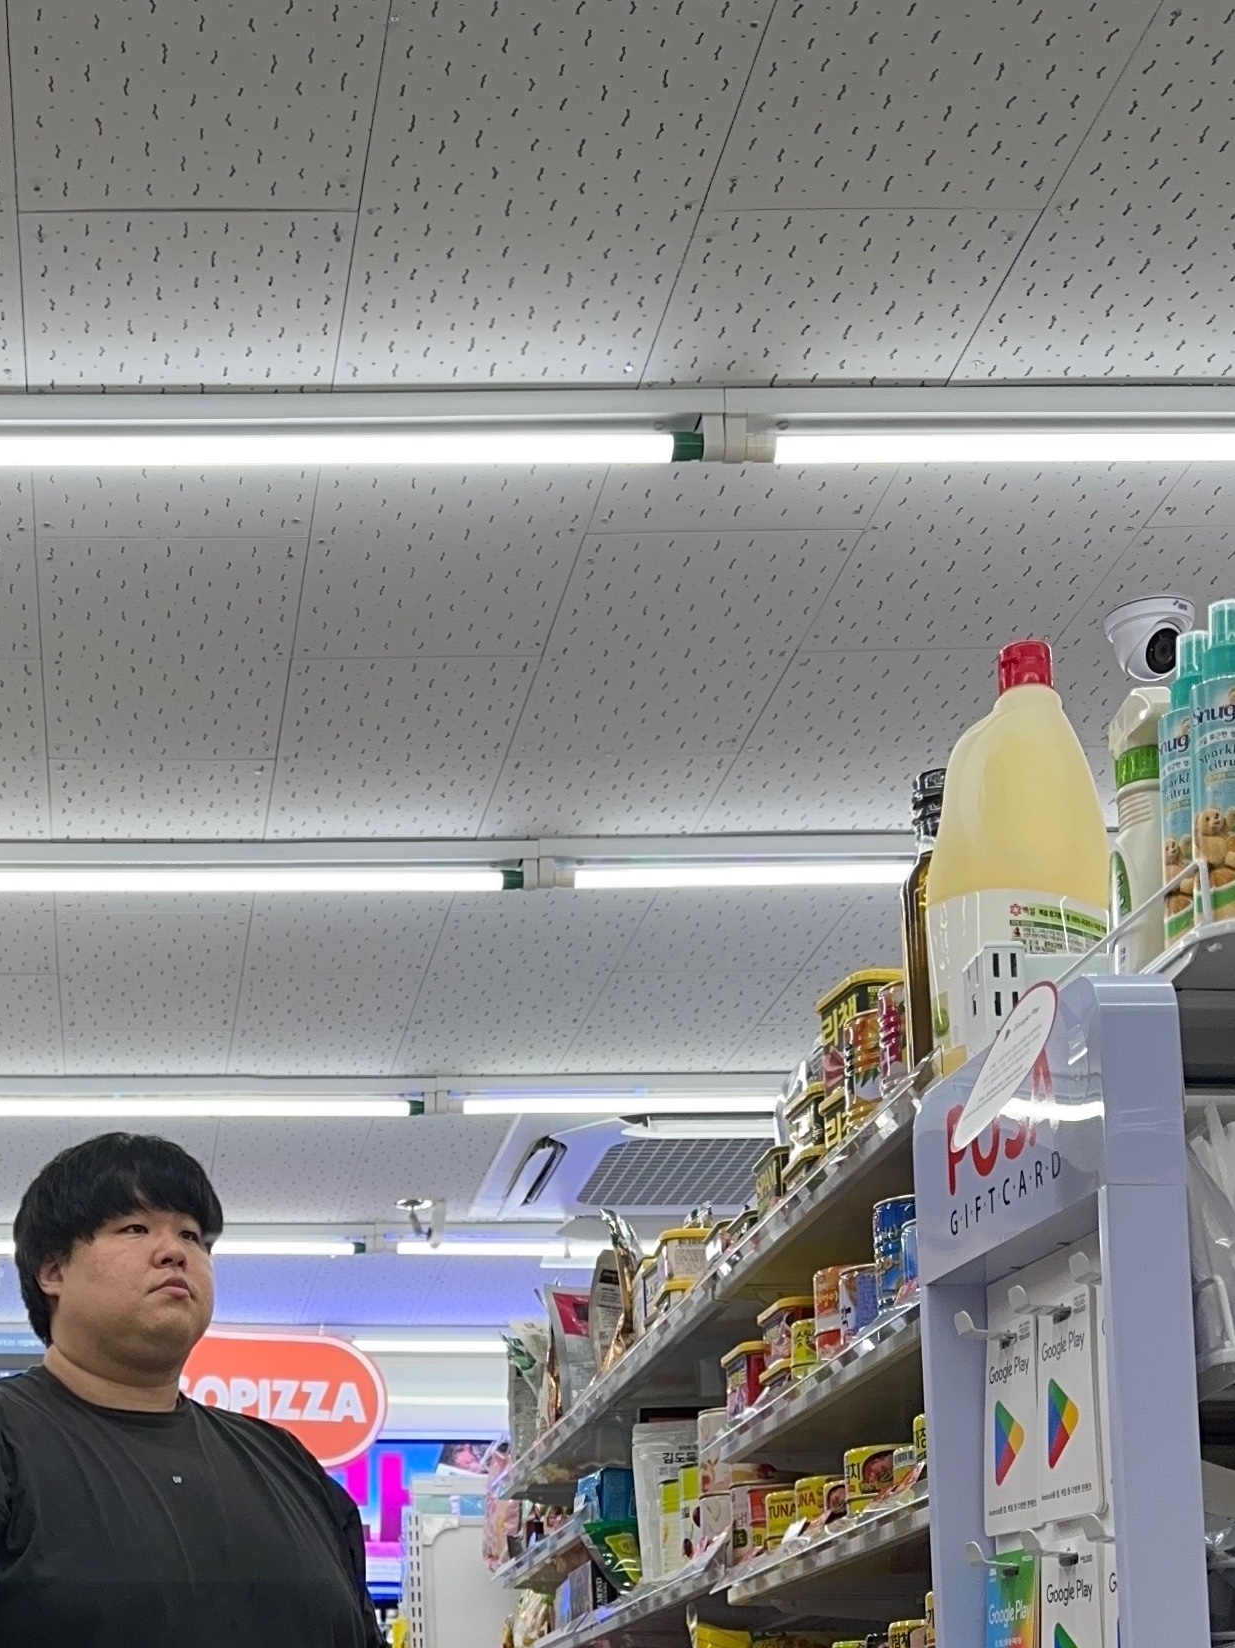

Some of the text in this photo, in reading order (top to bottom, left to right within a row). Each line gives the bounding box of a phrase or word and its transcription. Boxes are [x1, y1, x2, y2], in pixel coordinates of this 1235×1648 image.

[1159, 733, 1191, 757] nug
[1041, 1330, 1086, 1362] Google Play
[989, 1356, 1031, 1386] Google Play
[178, 1374, 368, 1424] OPIZZA
[768, 1502, 797, 1519] TUNA
[1046, 1582, 1075, 1607] Google
[1076, 1578, 1094, 1602] Play
[988, 1598, 1032, 1629] Google Play
